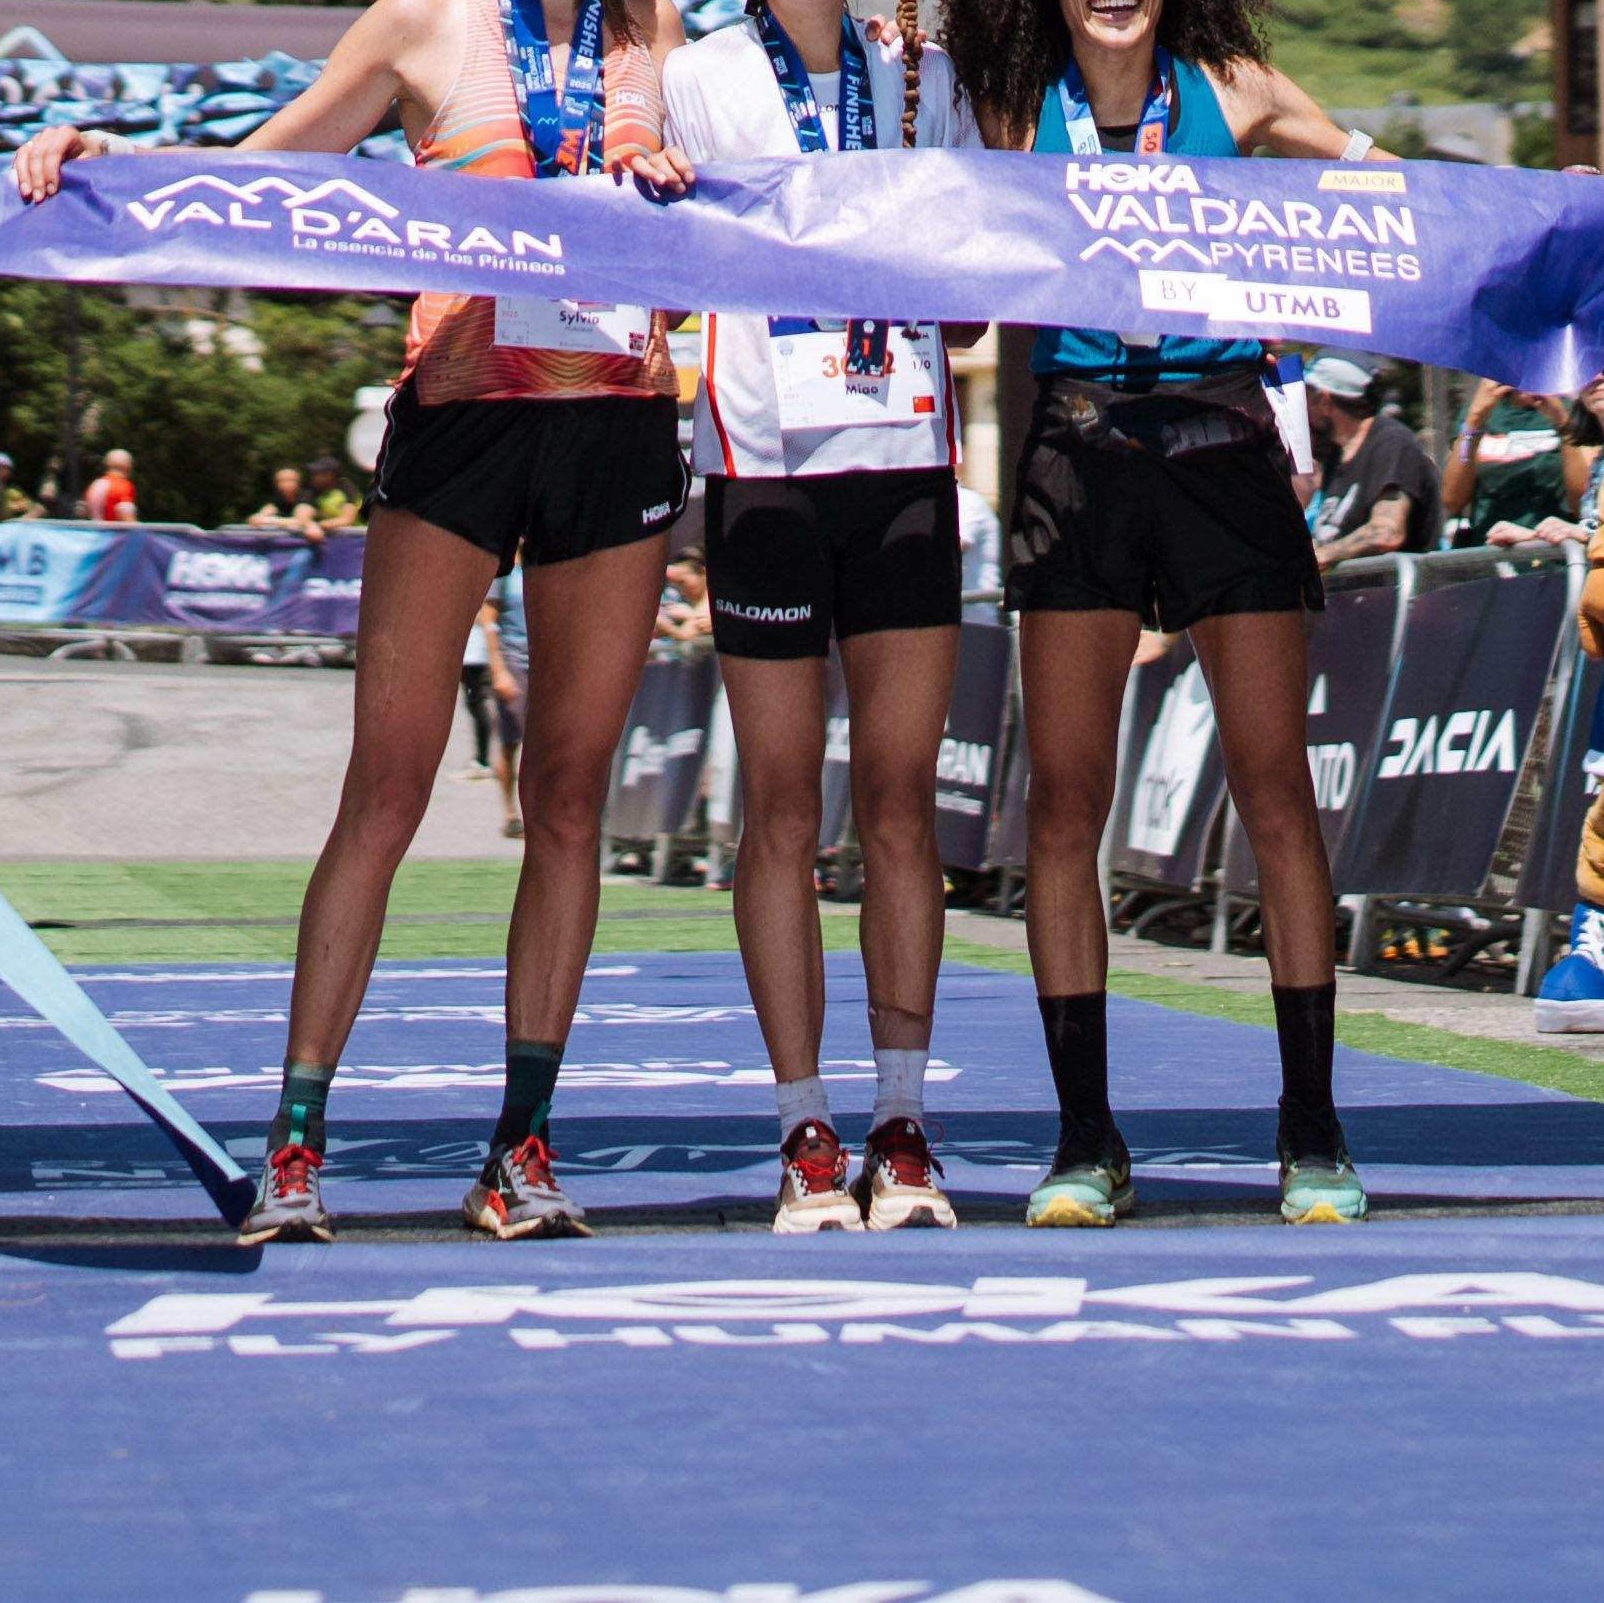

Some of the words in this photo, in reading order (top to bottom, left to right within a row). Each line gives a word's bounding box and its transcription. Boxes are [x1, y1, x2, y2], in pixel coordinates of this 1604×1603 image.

[1065, 163, 1201, 193] HOKA
[1333, 174, 1397, 189] MAJOR
[127, 200, 272, 230] VAL
[291, 207, 565, 259] D'ARAN
[293, 234, 318, 251] La
[324, 239, 405, 259] esencia
[413, 247, 438, 263] de
[444, 251, 473, 268] los
[479, 254, 566, 276] Pirineos
[1211, 242, 1421, 282] PYRENEES
[1162, 279, 1196, 301] BY
[1245, 290, 1341, 319] UTMB
[715, 598, 812, 623] SALOMON
[1378, 708, 1517, 779] DACIA
[110, 1329, 458, 1360] FLY
[508, 1320, 1360, 1350] HUMAN
